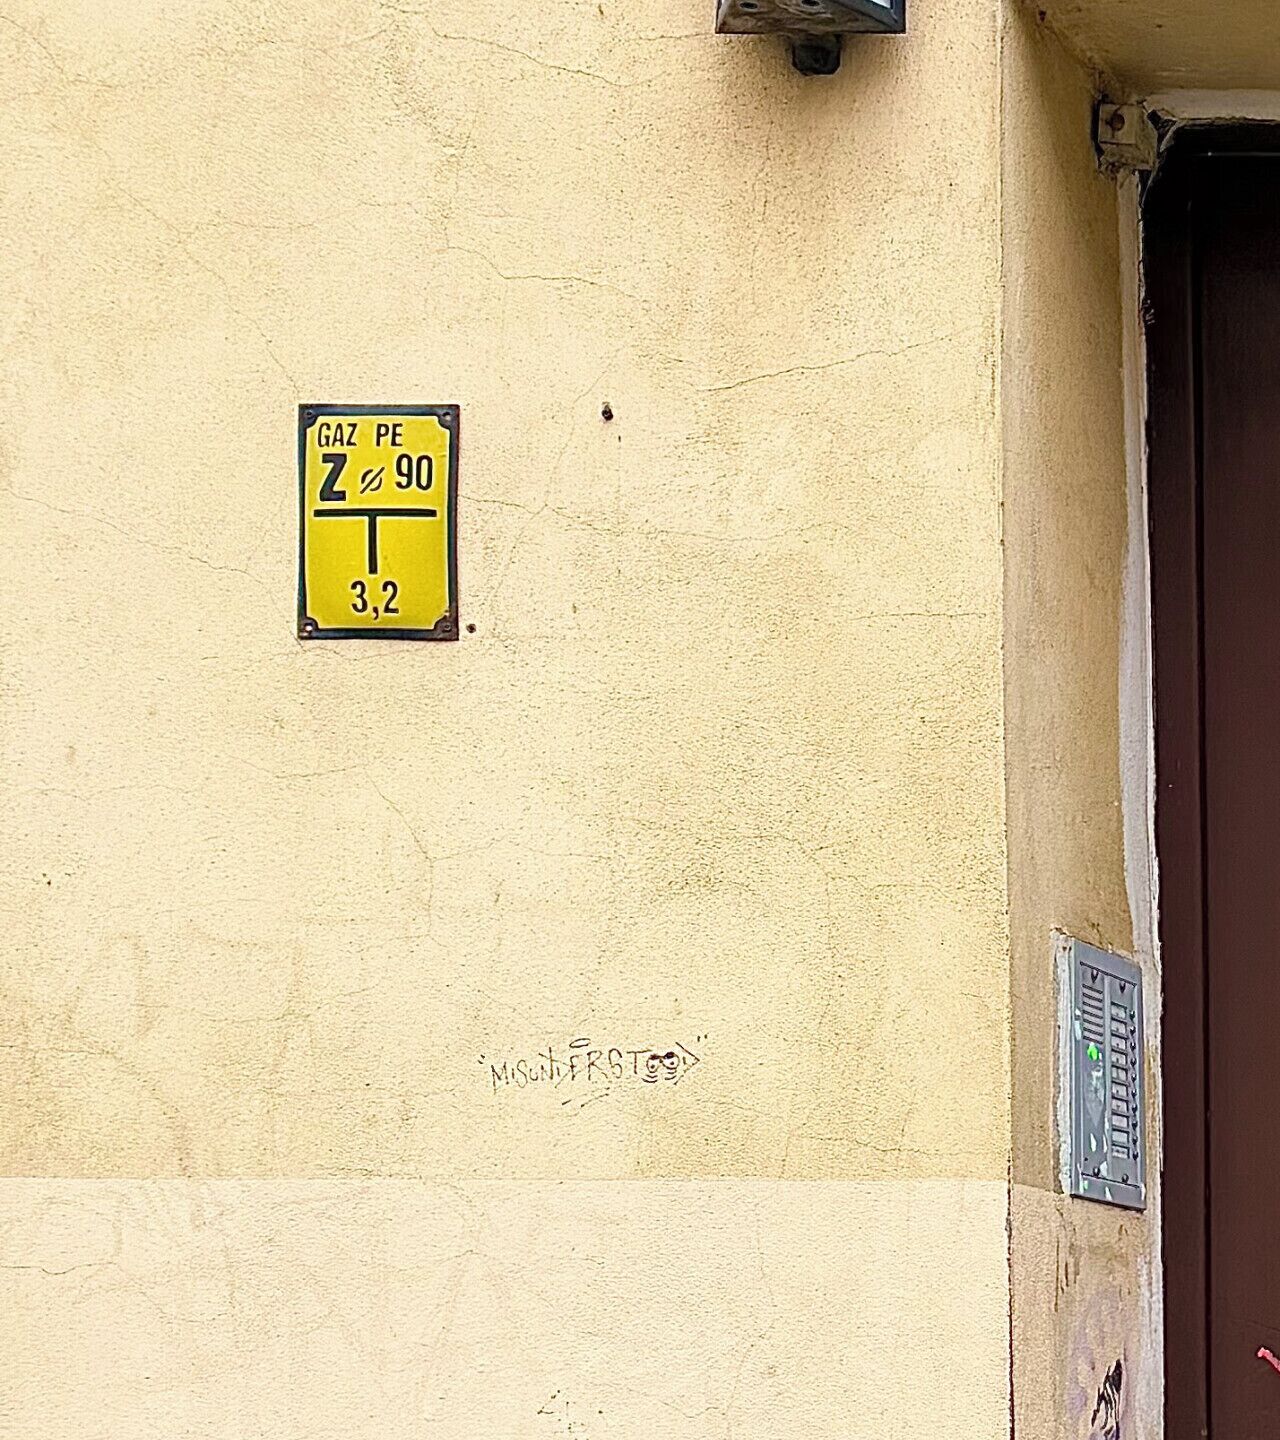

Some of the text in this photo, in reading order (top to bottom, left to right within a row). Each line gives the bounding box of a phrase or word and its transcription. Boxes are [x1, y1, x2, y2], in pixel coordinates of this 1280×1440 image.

[317, 422, 403, 447] GAZ PE
[319, 453, 347, 501] Z
[395, 453, 433, 490] 90
[350, 580, 399, 620] 3,2
